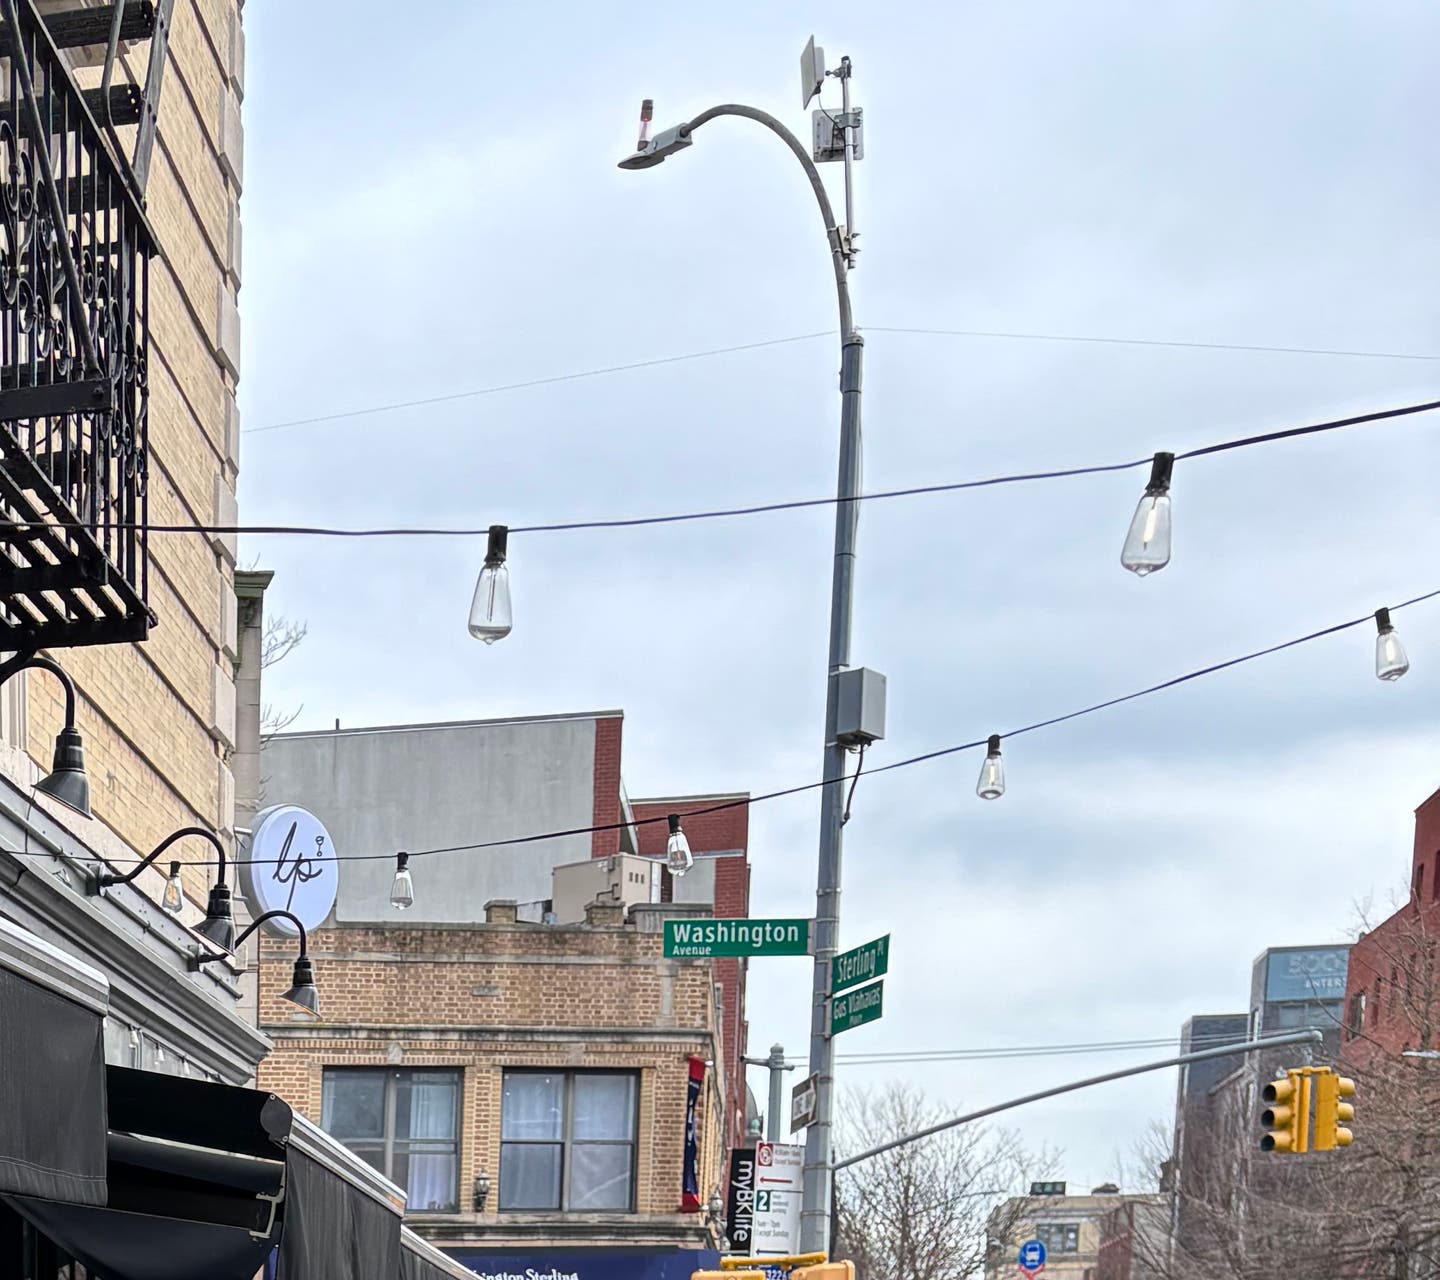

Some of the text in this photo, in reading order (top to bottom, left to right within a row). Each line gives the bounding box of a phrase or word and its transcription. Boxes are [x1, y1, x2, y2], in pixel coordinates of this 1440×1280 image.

[673, 922, 799, 948] Washington
[672, 945, 712, 955] Avenue
[837, 948, 876, 983] Sterling
